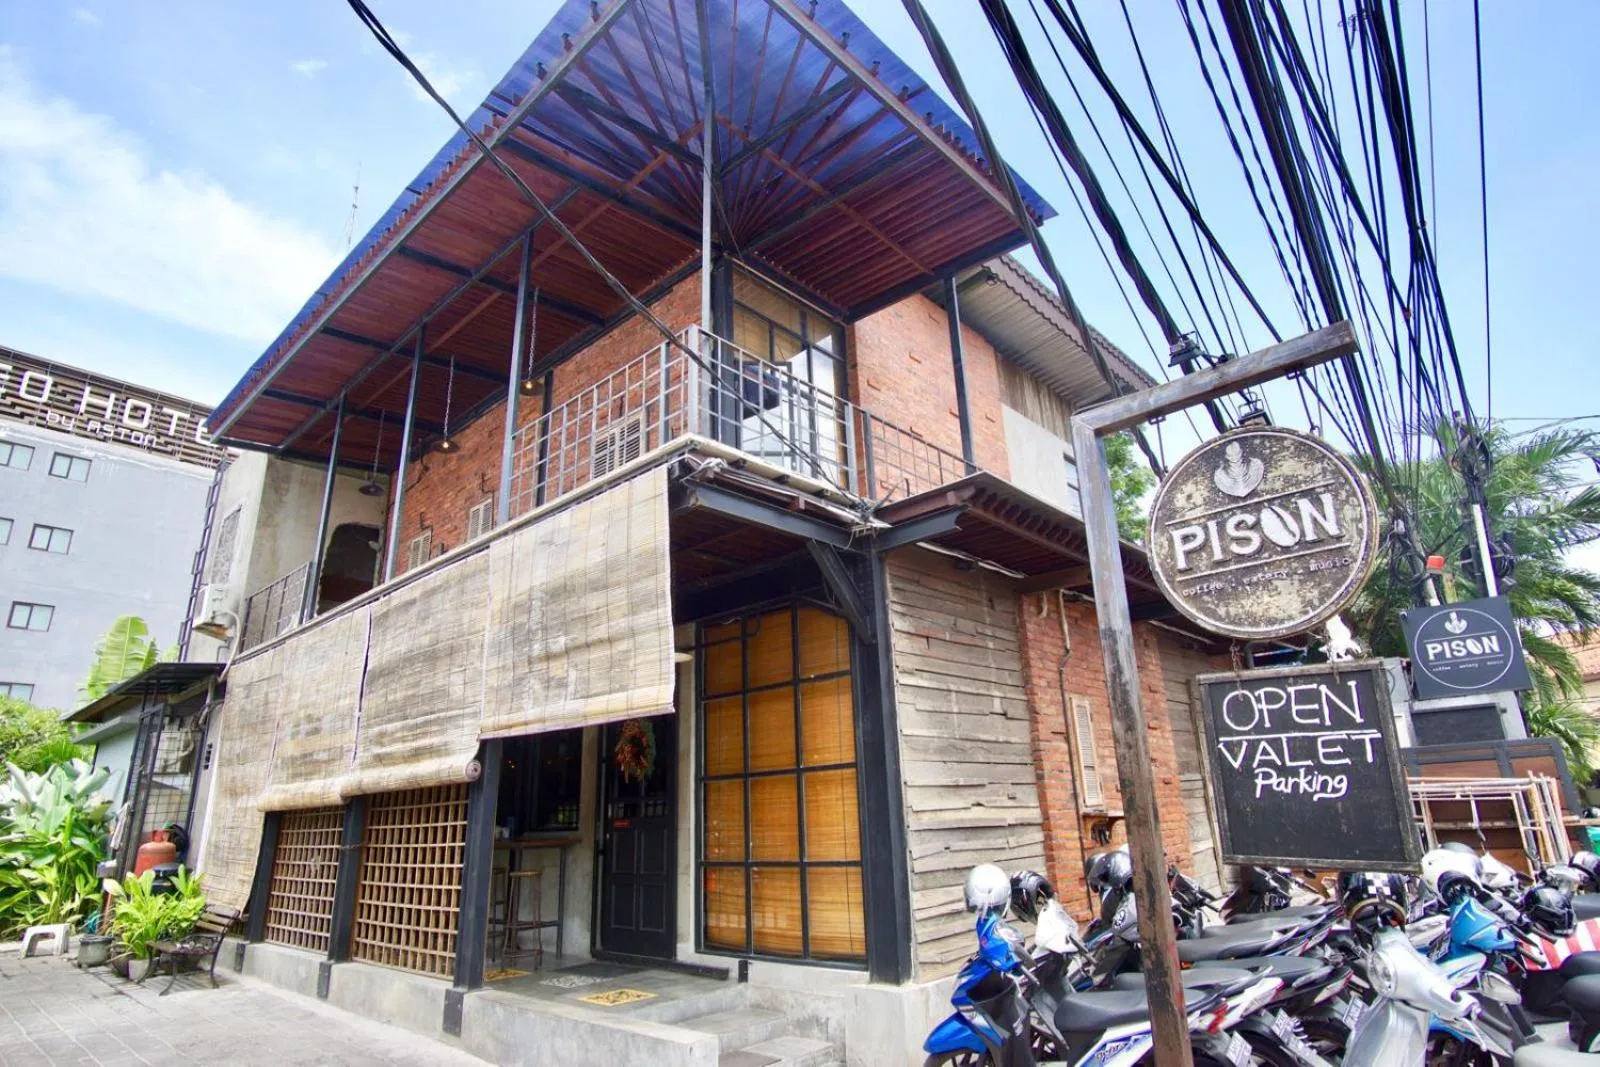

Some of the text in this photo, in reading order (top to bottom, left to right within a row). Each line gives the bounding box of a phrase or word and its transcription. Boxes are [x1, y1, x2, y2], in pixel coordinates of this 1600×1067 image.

[45, 408, 76, 431] by
[1170, 492, 1344, 572] PISON
[1309, 556, 1351, 572] music
[1425, 635, 1500, 660] PISON
[1223, 680, 1365, 731] OPEN
[1218, 732, 1382, 770] VALET
[1254, 767, 1348, 802] Parking
